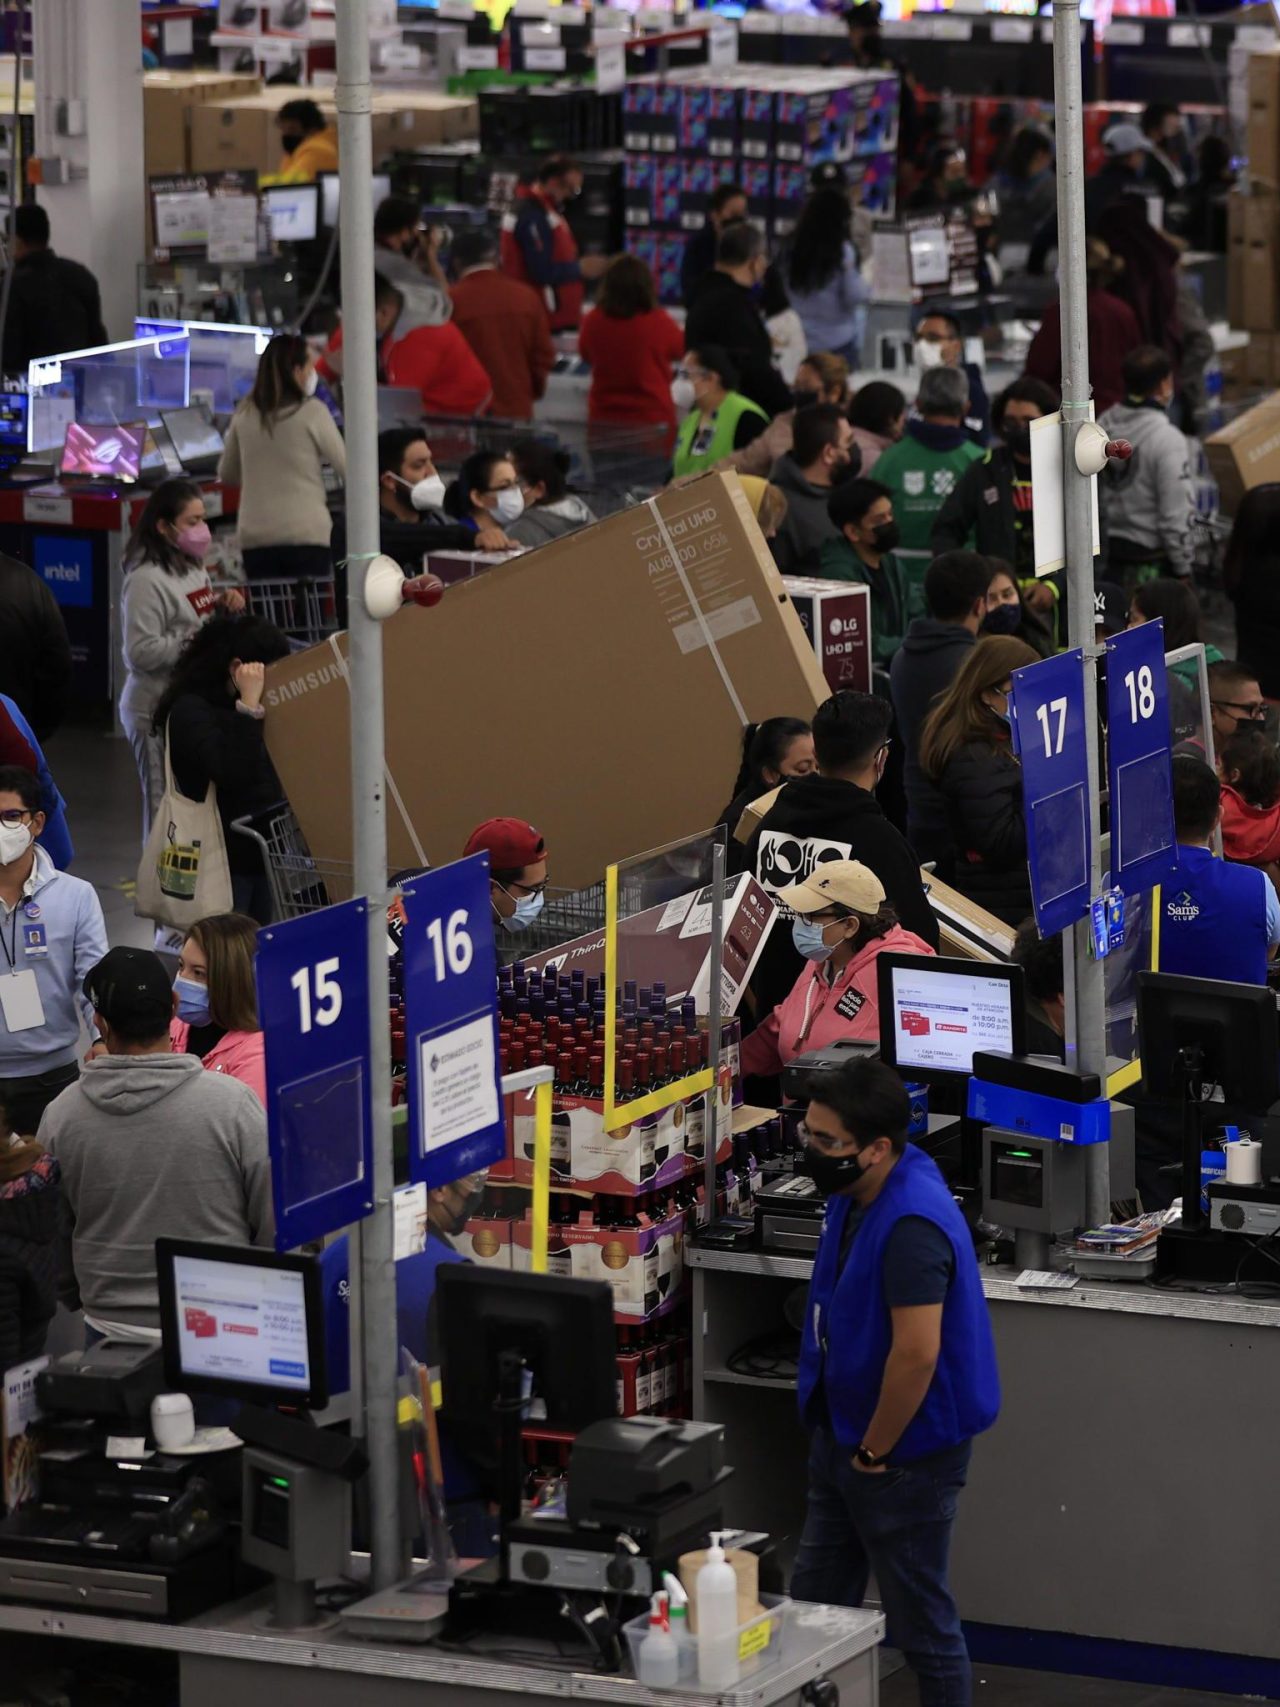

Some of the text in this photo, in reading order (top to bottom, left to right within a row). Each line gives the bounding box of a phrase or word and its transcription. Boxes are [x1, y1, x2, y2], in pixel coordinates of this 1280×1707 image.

[636, 507, 717, 551] Crytal UHD
[44, 562, 80, 581] intel
[648, 545, 697, 577] AU800
[843, 618, 858, 631] LG
[826, 643, 844, 655] UHD
[266, 656, 352, 706] SAMSUN
[838, 657, 855, 678] 75
[1125, 665, 1155, 724] 18
[1036, 696, 1067, 758] 17
[755, 903, 765, 915] LG
[1167, 903, 1200, 916] Sam's
[427, 908, 473, 983] 16
[291, 946, 342, 1034] 15
